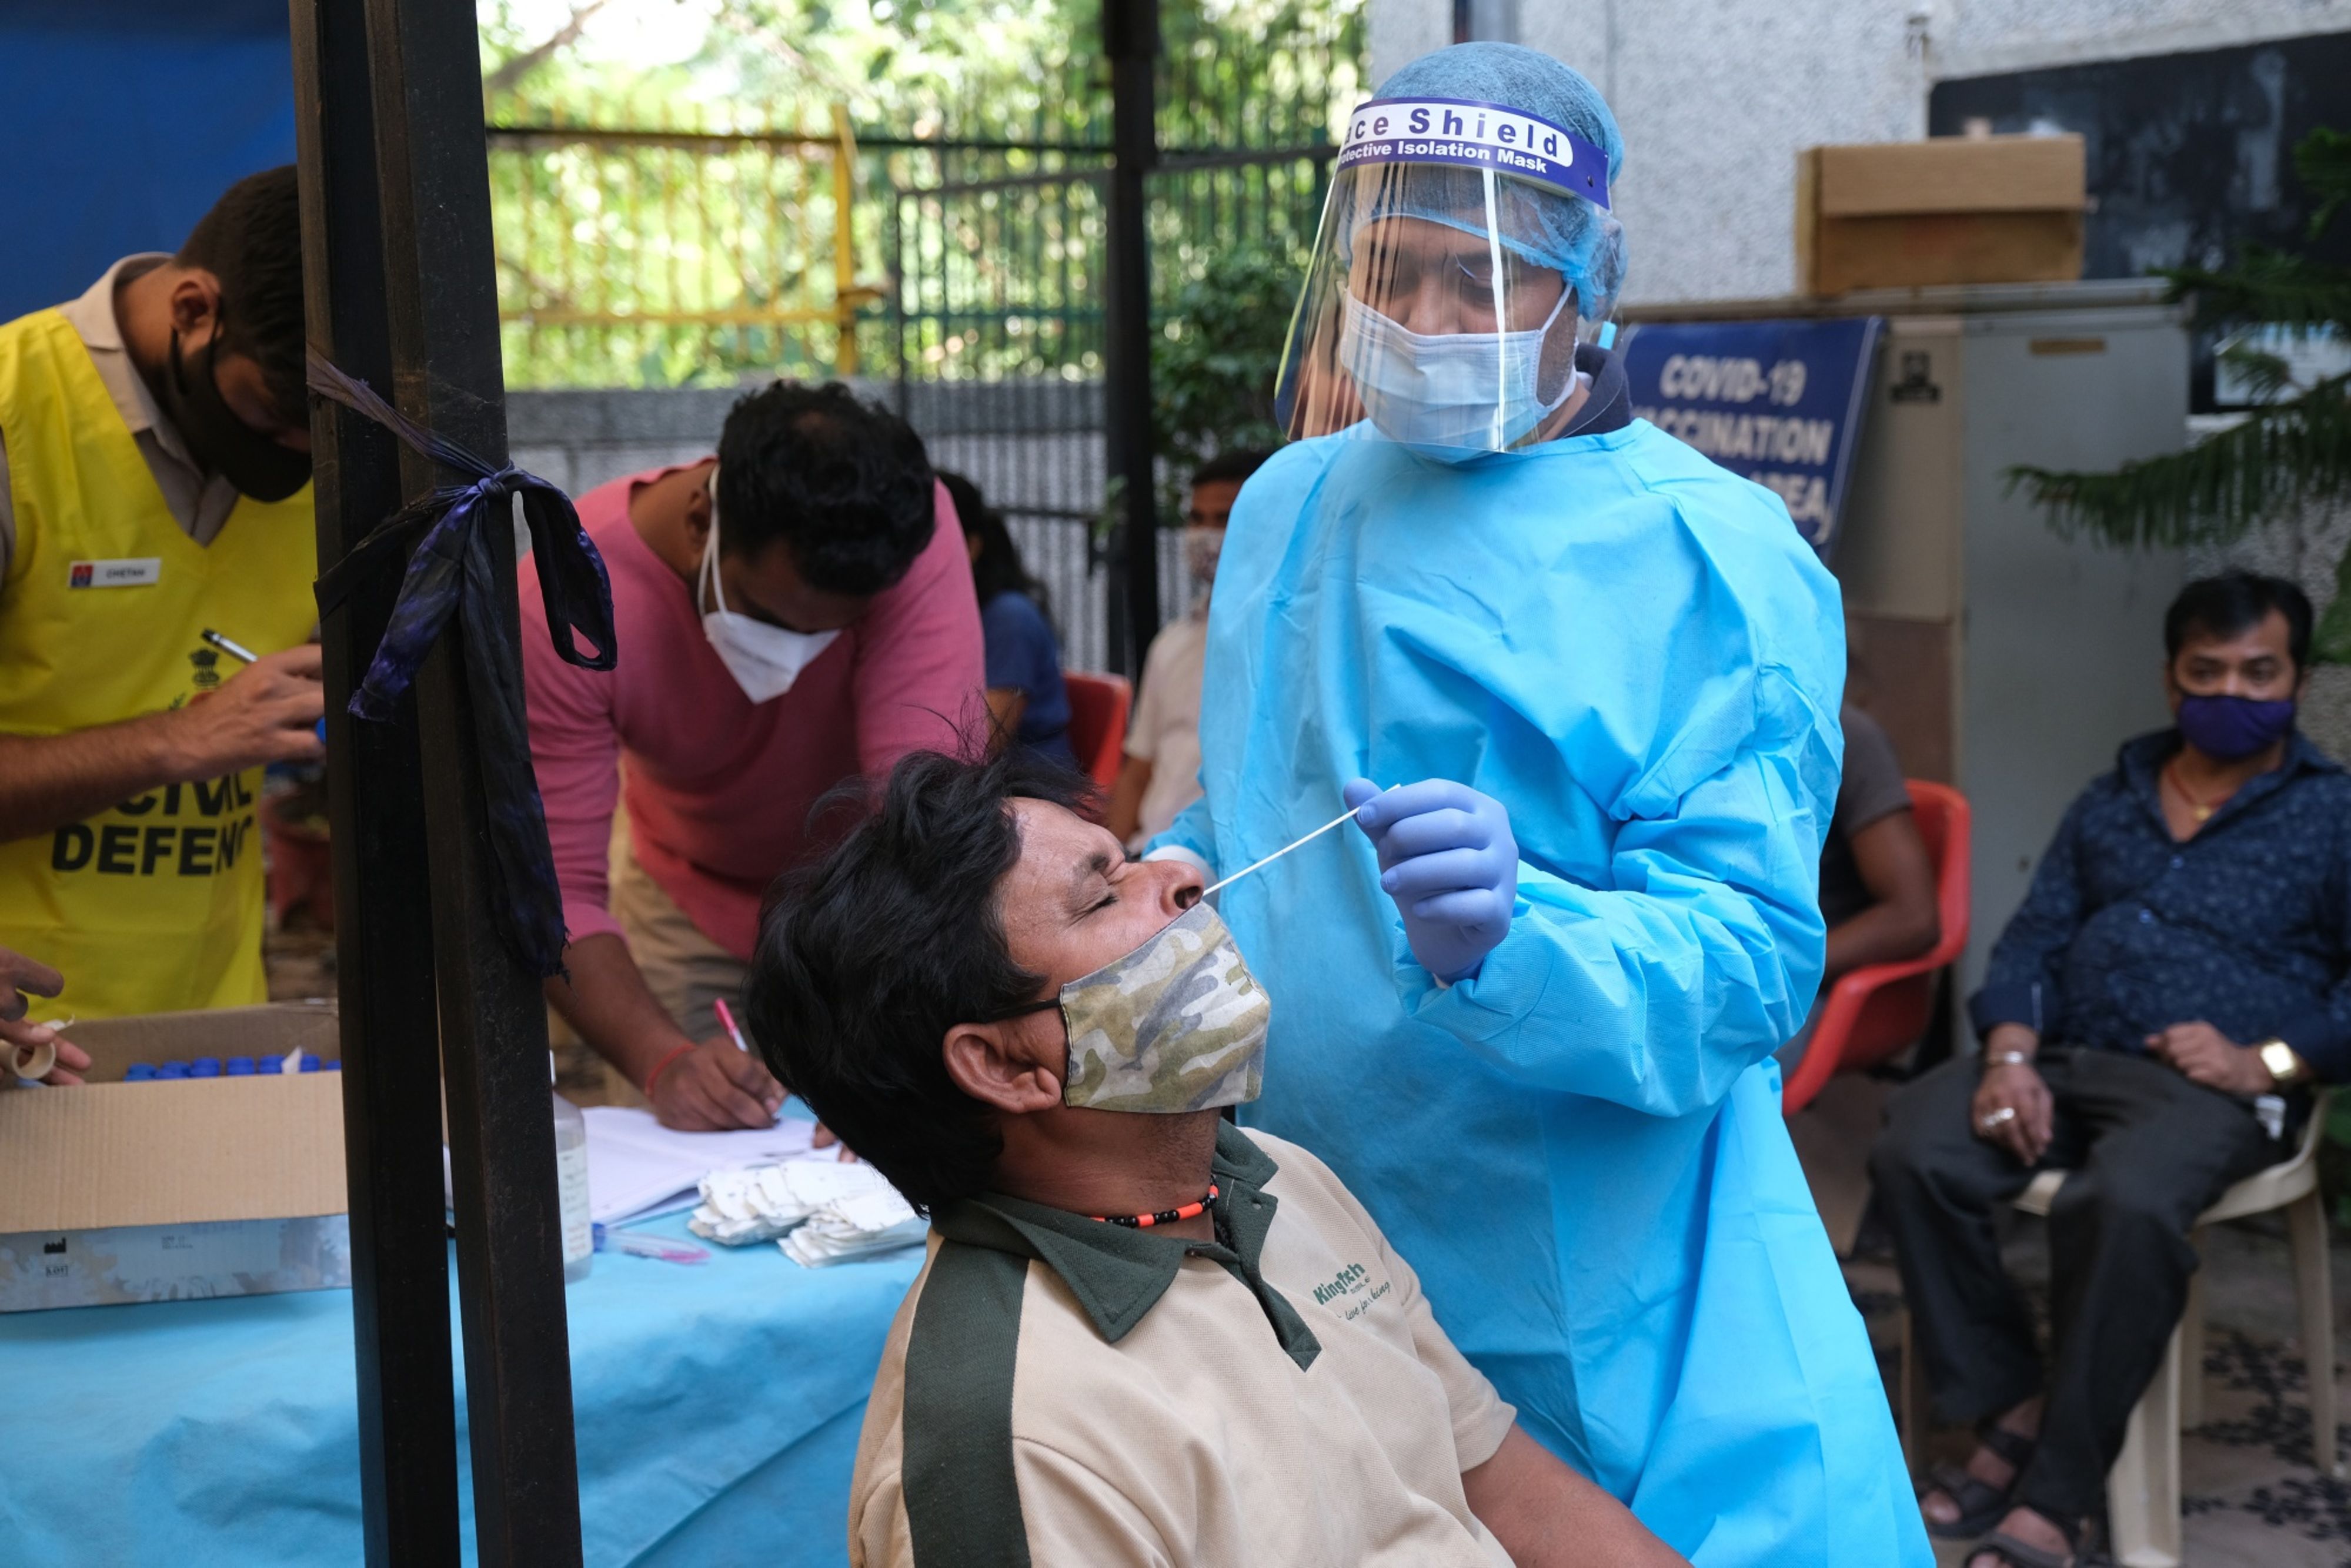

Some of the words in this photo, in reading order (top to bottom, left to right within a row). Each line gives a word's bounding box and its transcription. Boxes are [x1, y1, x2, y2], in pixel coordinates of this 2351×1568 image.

[1339, 142, 1392, 164] otective
[1397, 141, 1490, 160] Isolation
[1497, 149, 1547, 173] Mask
[1344, 116, 1389, 145] ace
[1408, 108, 1557, 158] Shield
[1659, 355, 1807, 406] COVID-19
[1632, 407, 1833, 464] CCINATION
